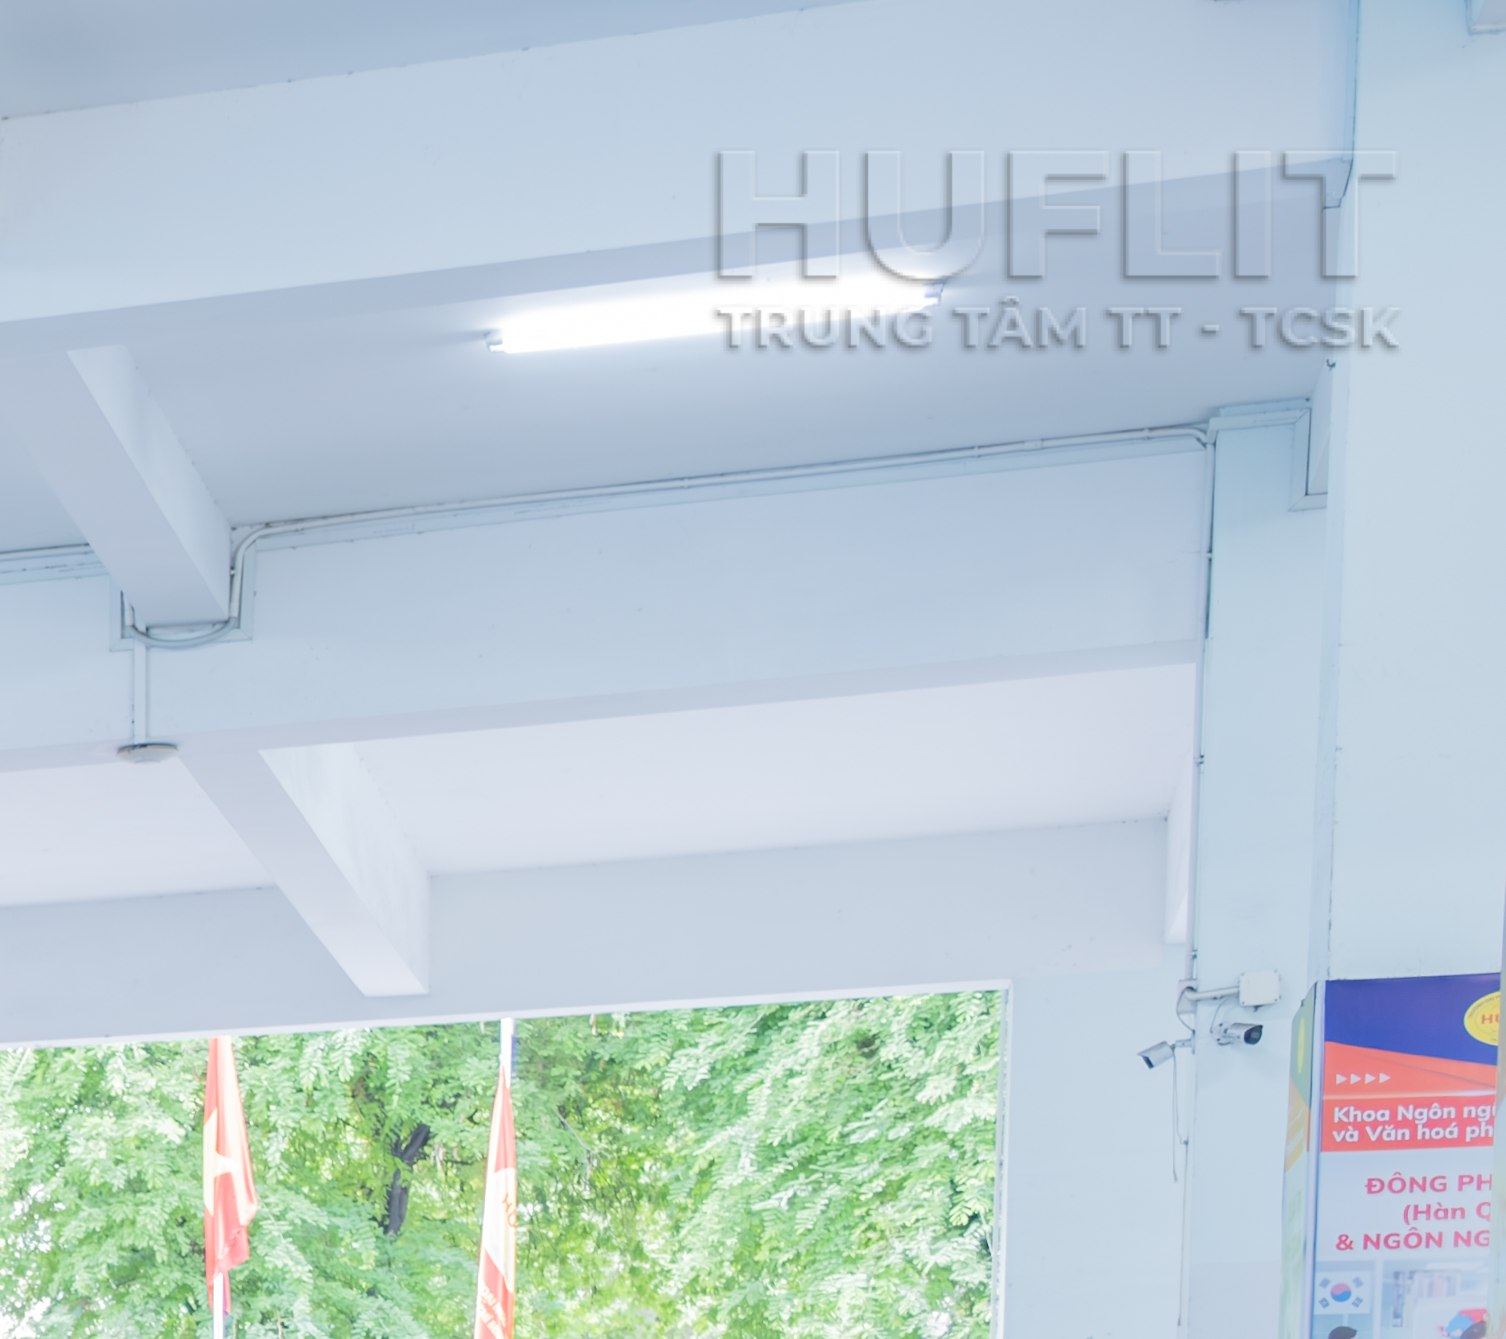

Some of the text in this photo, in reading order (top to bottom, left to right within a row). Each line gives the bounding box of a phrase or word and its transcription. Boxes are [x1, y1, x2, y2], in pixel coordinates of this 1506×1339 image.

[1333, 1103, 1456, 1124] Khoa Ngôn
[1333, 1124, 1458, 1142] và Văn hoá
[1365, 1172, 1447, 1194] ĐÔNG
[1403, 1203, 1466, 1225] (Hàn
[1336, 1227, 1443, 1251] & NGÔN
